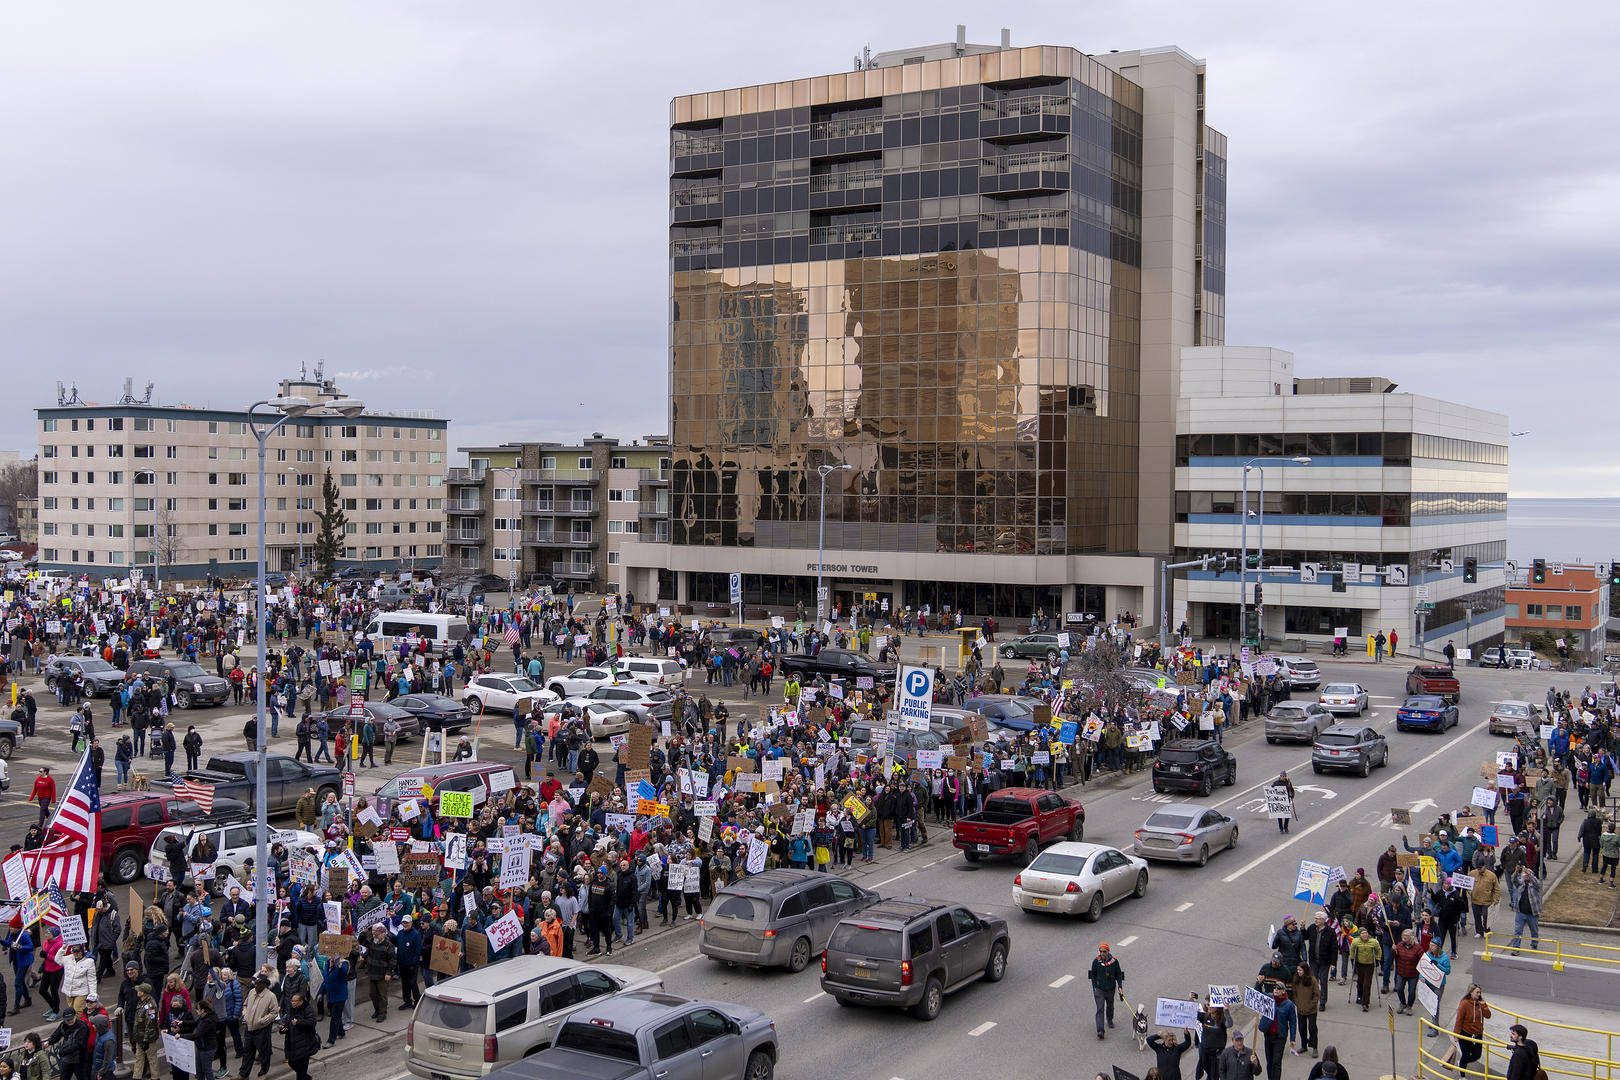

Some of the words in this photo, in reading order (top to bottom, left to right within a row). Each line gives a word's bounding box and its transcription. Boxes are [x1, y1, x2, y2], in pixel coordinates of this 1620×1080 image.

[807, 563, 847, 572] PETERSON
[850, 565, 878, 573] TOWER
[904, 698, 927, 709] PUBLIC
[900, 706, 929, 719] PARKING
[398, 779, 418, 787] HANDS
[681, 782, 707, 796] OVE
[443, 792, 472, 803] SCIENCE
[442, 806, 471, 816] SILENCED
[343, 849, 367, 884] DEMOCRACY
[489, 920, 507, 935] Where
[499, 926, 508, 936] Do
[497, 927, 520, 947] Start?
[1210, 986, 1222, 996] ALL
[1222, 987, 1237, 996] ARE
[1211, 994, 1242, 1005] WELCOME
[1245, 986, 1260, 1002] TAKE
[1259, 993, 1274, 1008] AWAY
[1253, 1000, 1274, 1020] CROWN
